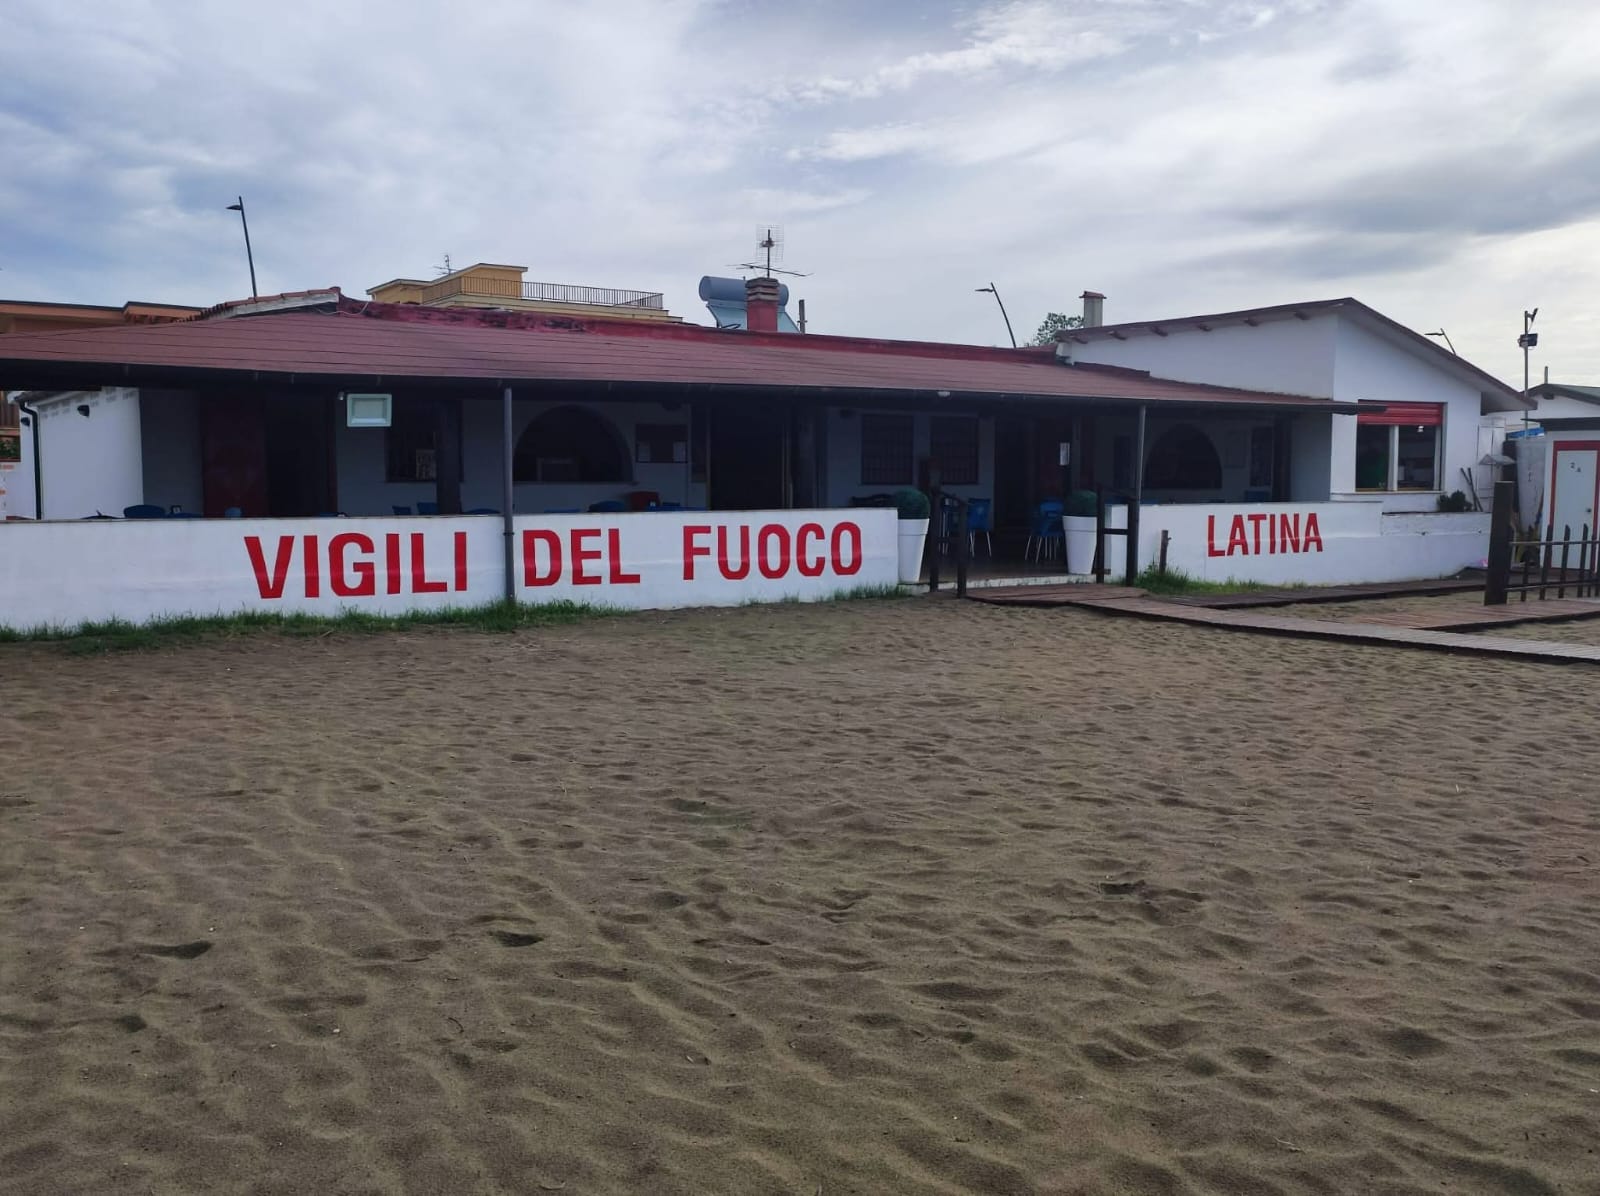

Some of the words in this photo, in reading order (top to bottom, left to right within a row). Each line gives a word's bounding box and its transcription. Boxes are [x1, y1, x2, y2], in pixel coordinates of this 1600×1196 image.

[244, 531, 467, 599] VIGILI
[524, 528, 641, 586] DEL
[683, 522, 862, 580] FUOCO
[1207, 512, 1323, 558] LATINA
